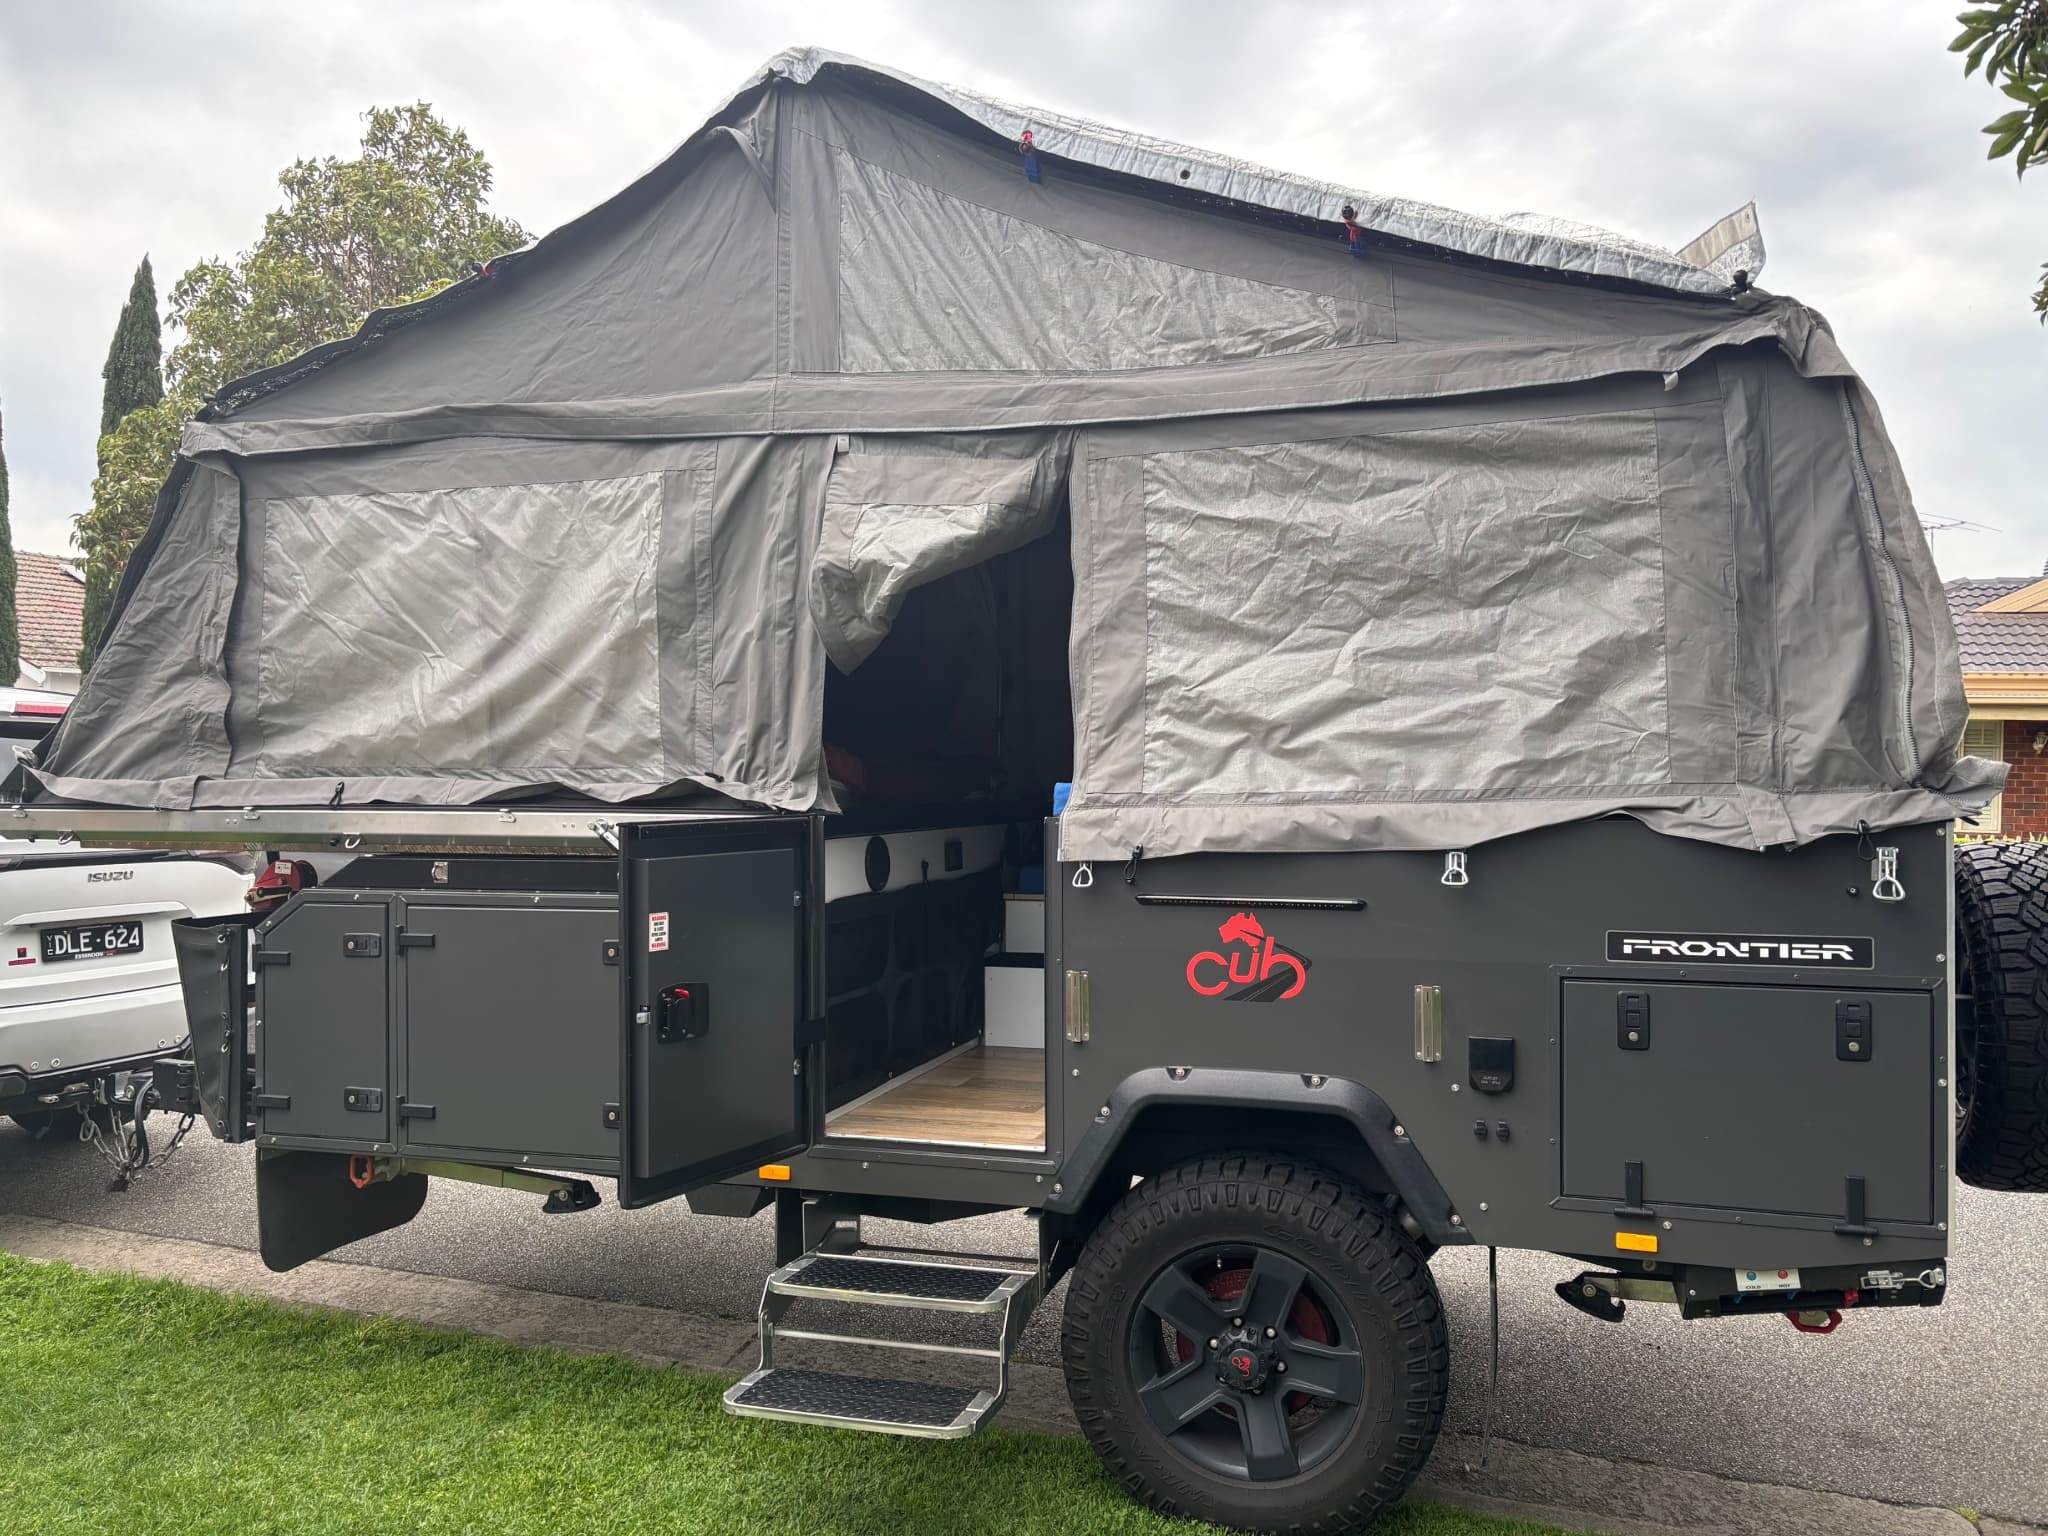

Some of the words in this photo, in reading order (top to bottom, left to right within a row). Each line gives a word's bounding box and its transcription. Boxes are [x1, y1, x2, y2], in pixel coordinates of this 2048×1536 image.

[87, 870, 134, 883] ISUZU
[46, 934, 55, 956] VIC
[1623, 939, 1855, 961] FRONTIER
